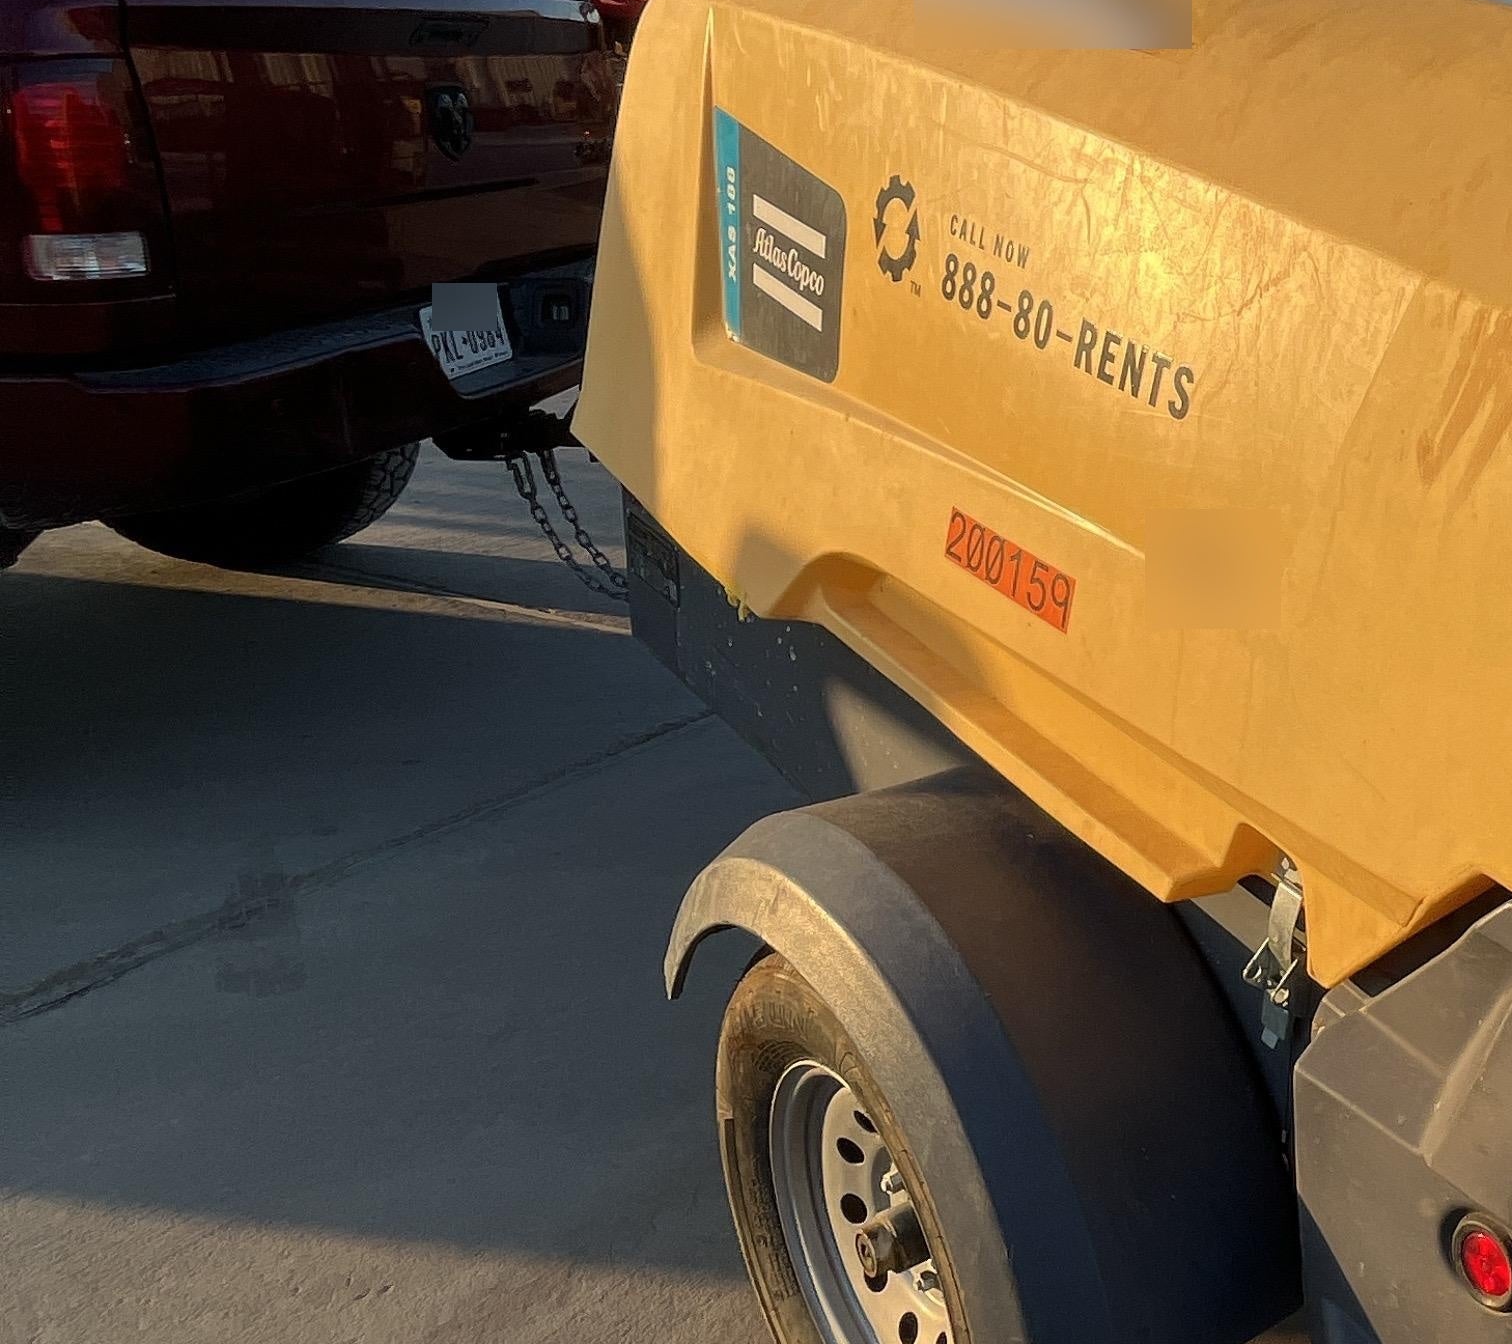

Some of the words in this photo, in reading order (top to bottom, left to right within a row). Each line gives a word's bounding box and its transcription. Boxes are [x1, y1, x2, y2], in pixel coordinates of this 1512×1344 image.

[726, 224, 737, 284] XAS
[949, 214, 986, 251] CALL
[993, 233, 1031, 270] NOW
[941, 252, 1196, 421] 888-80-RENTS
[945, 510, 1071, 631] 200159
